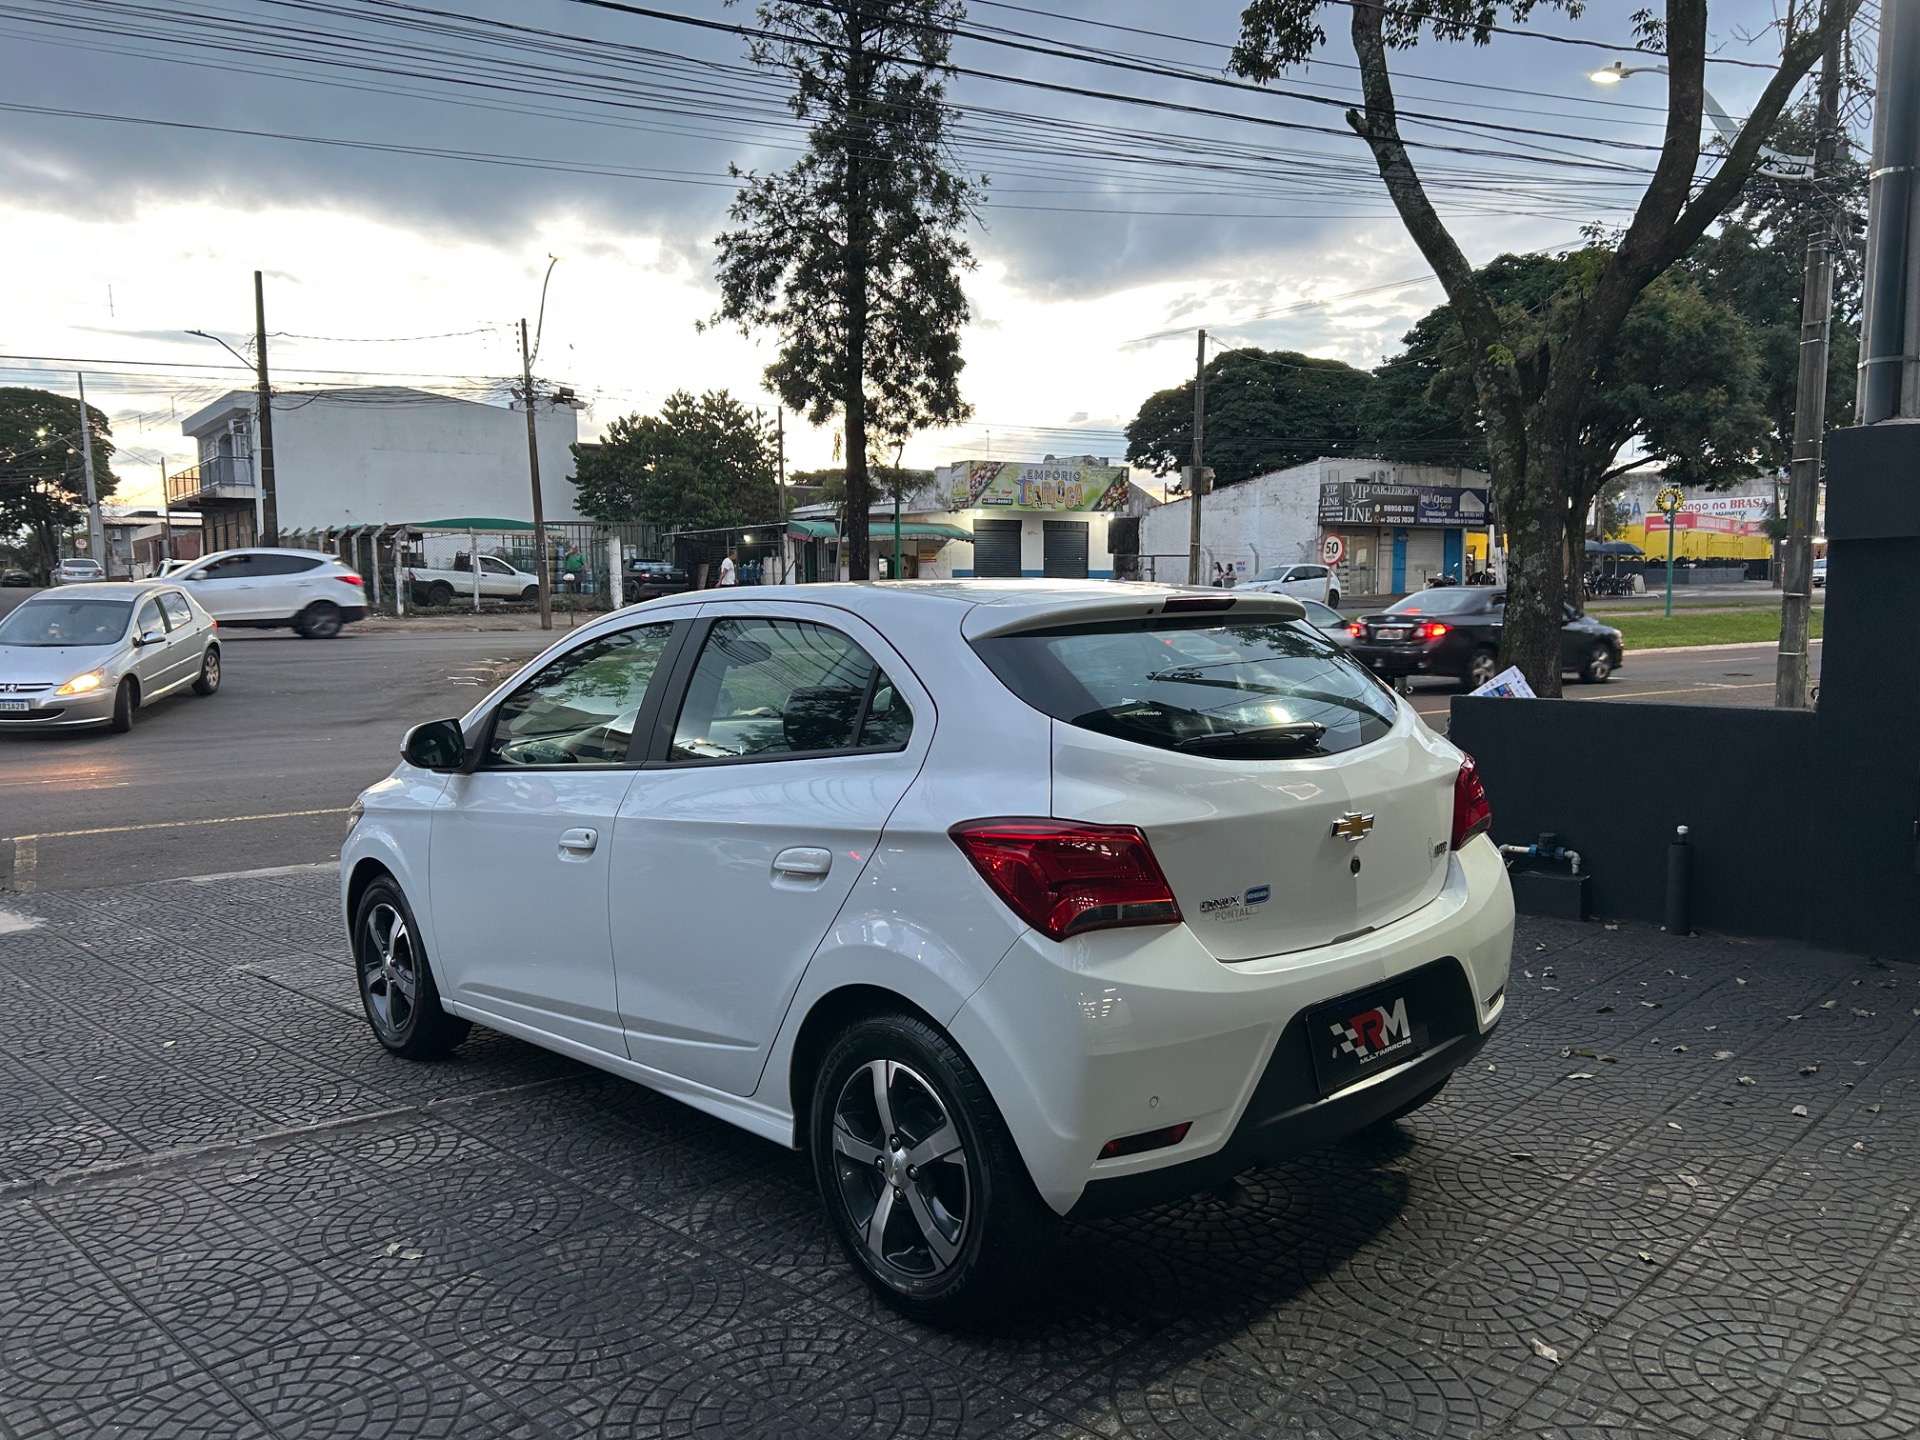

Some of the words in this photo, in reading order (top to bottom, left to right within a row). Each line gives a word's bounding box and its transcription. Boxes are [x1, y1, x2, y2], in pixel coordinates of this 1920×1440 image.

[1026, 468, 1082, 482] EMPÓRIO
[1022, 479, 1085, 509] CARIOCA
[1325, 484, 1338, 493] VIP
[1349, 484, 1370, 499] VIP
[1321, 496, 1340, 506] LINE
[1681, 502, 1709, 513] ango
[1712, 501, 1726, 510] na
[1343, 507, 1373, 523] LINE
[1325, 541, 1339, 555] 50
[1214, 907, 1251, 921] PONTAL
[1349, 996, 1411, 1050] RM
[1359, 1037, 1413, 1065] MULTIMARCAS
